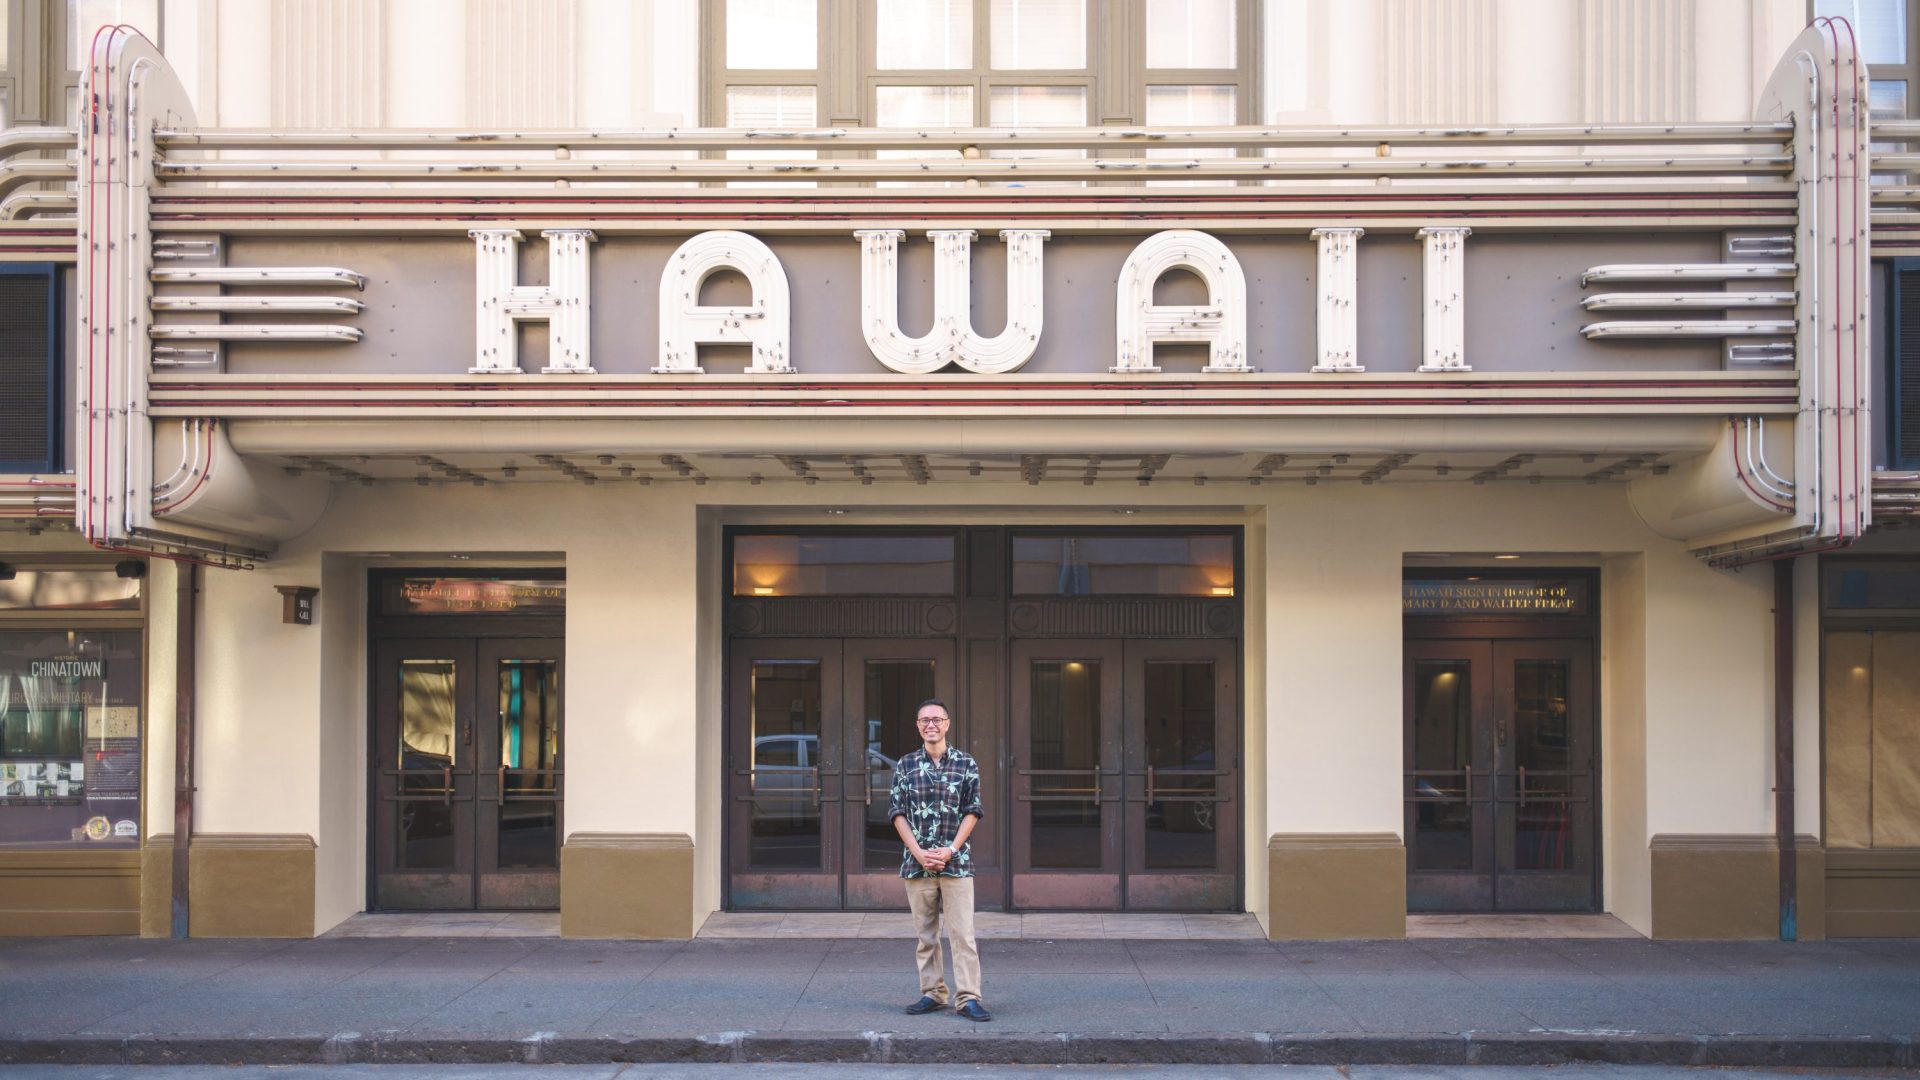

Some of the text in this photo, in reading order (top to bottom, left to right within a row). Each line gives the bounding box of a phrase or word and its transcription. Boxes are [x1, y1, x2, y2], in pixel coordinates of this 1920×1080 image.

[467, 228, 1474, 374] HAWAII
[1456, 588, 1484, 597] SIGN
[1488, 588, 1500, 597] IN
[1504, 588, 1547, 597] HONOR
[1550, 588, 1567, 597] OF
[1402, 600, 1437, 608] MARY
[1454, 600, 1480, 608] AND
[1482, 600, 1532, 608] WALTER
[1536, 600, 1575, 608] FREAR
[31, 661, 101, 677] CHINATOWN
[51, 691, 93, 704] MILITARY
